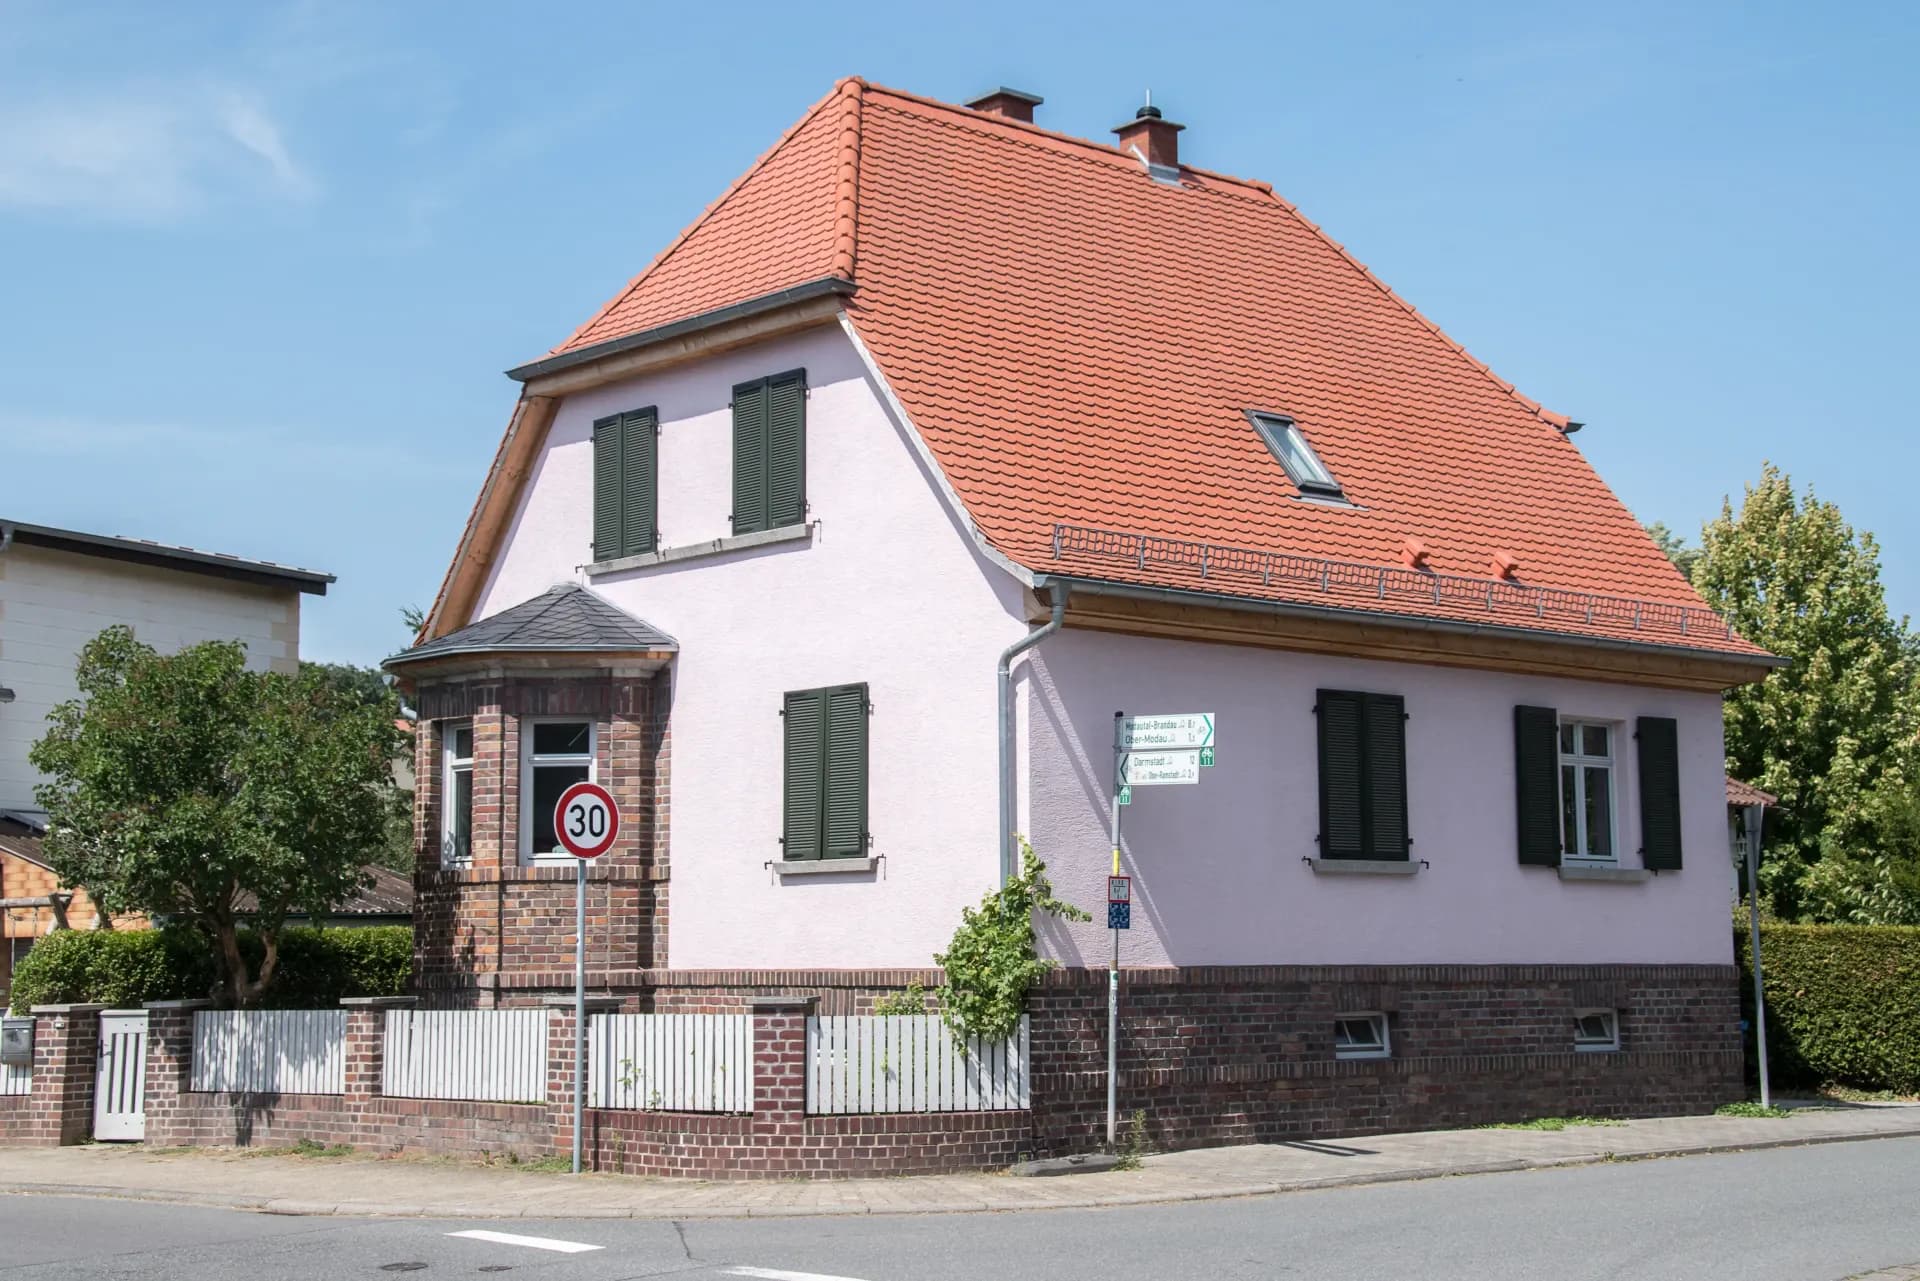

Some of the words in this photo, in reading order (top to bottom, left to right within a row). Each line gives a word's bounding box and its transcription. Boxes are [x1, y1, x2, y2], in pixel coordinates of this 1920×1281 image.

[1125, 734, 1168, 744] Ober-Modau
[1134, 757, 1165, 767] Darmstadt
[569, 804, 605, 838] 30
